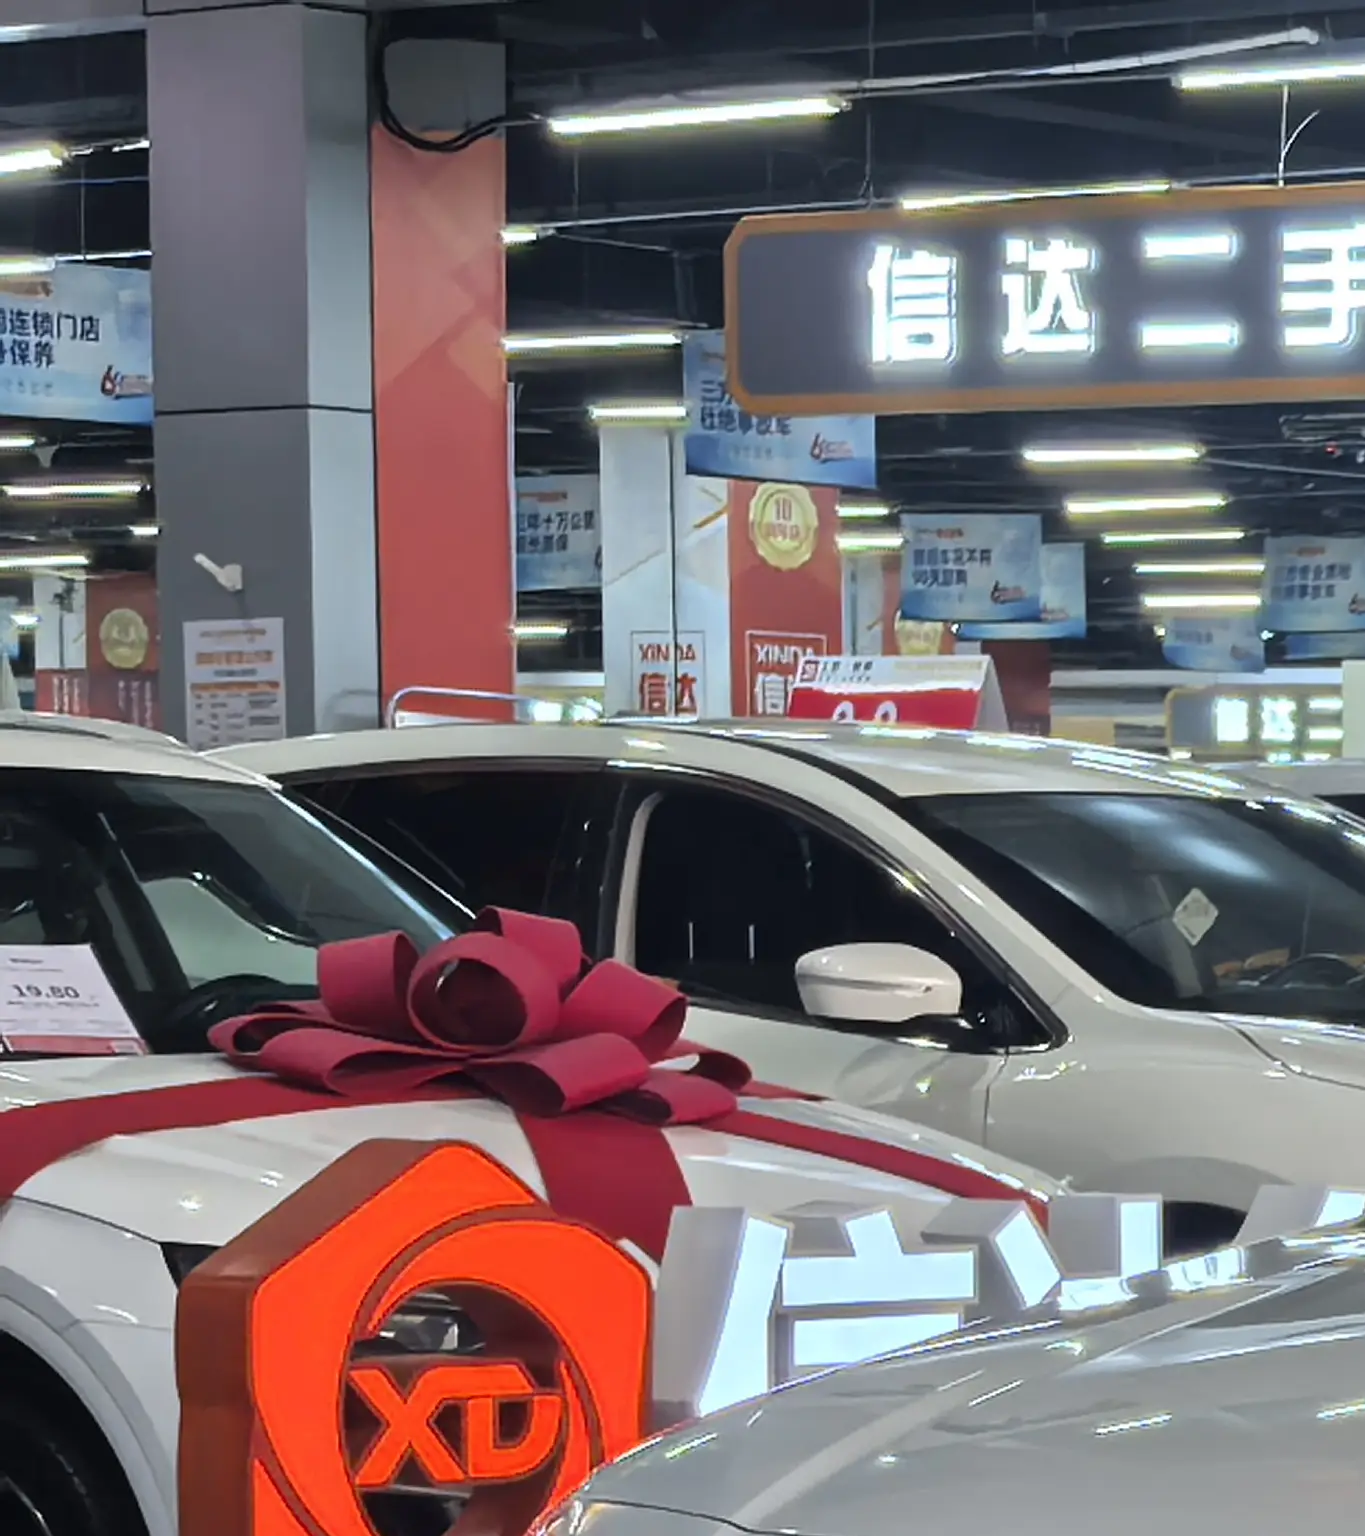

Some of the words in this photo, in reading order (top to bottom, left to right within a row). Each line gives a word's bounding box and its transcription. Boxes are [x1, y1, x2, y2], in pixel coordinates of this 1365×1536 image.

[638, 643, 697, 662] XINDA
[638, 672, 697, 715] 信达
[12, 984, 80, 999] 19.80
[349, 1364, 563, 1486] XD
